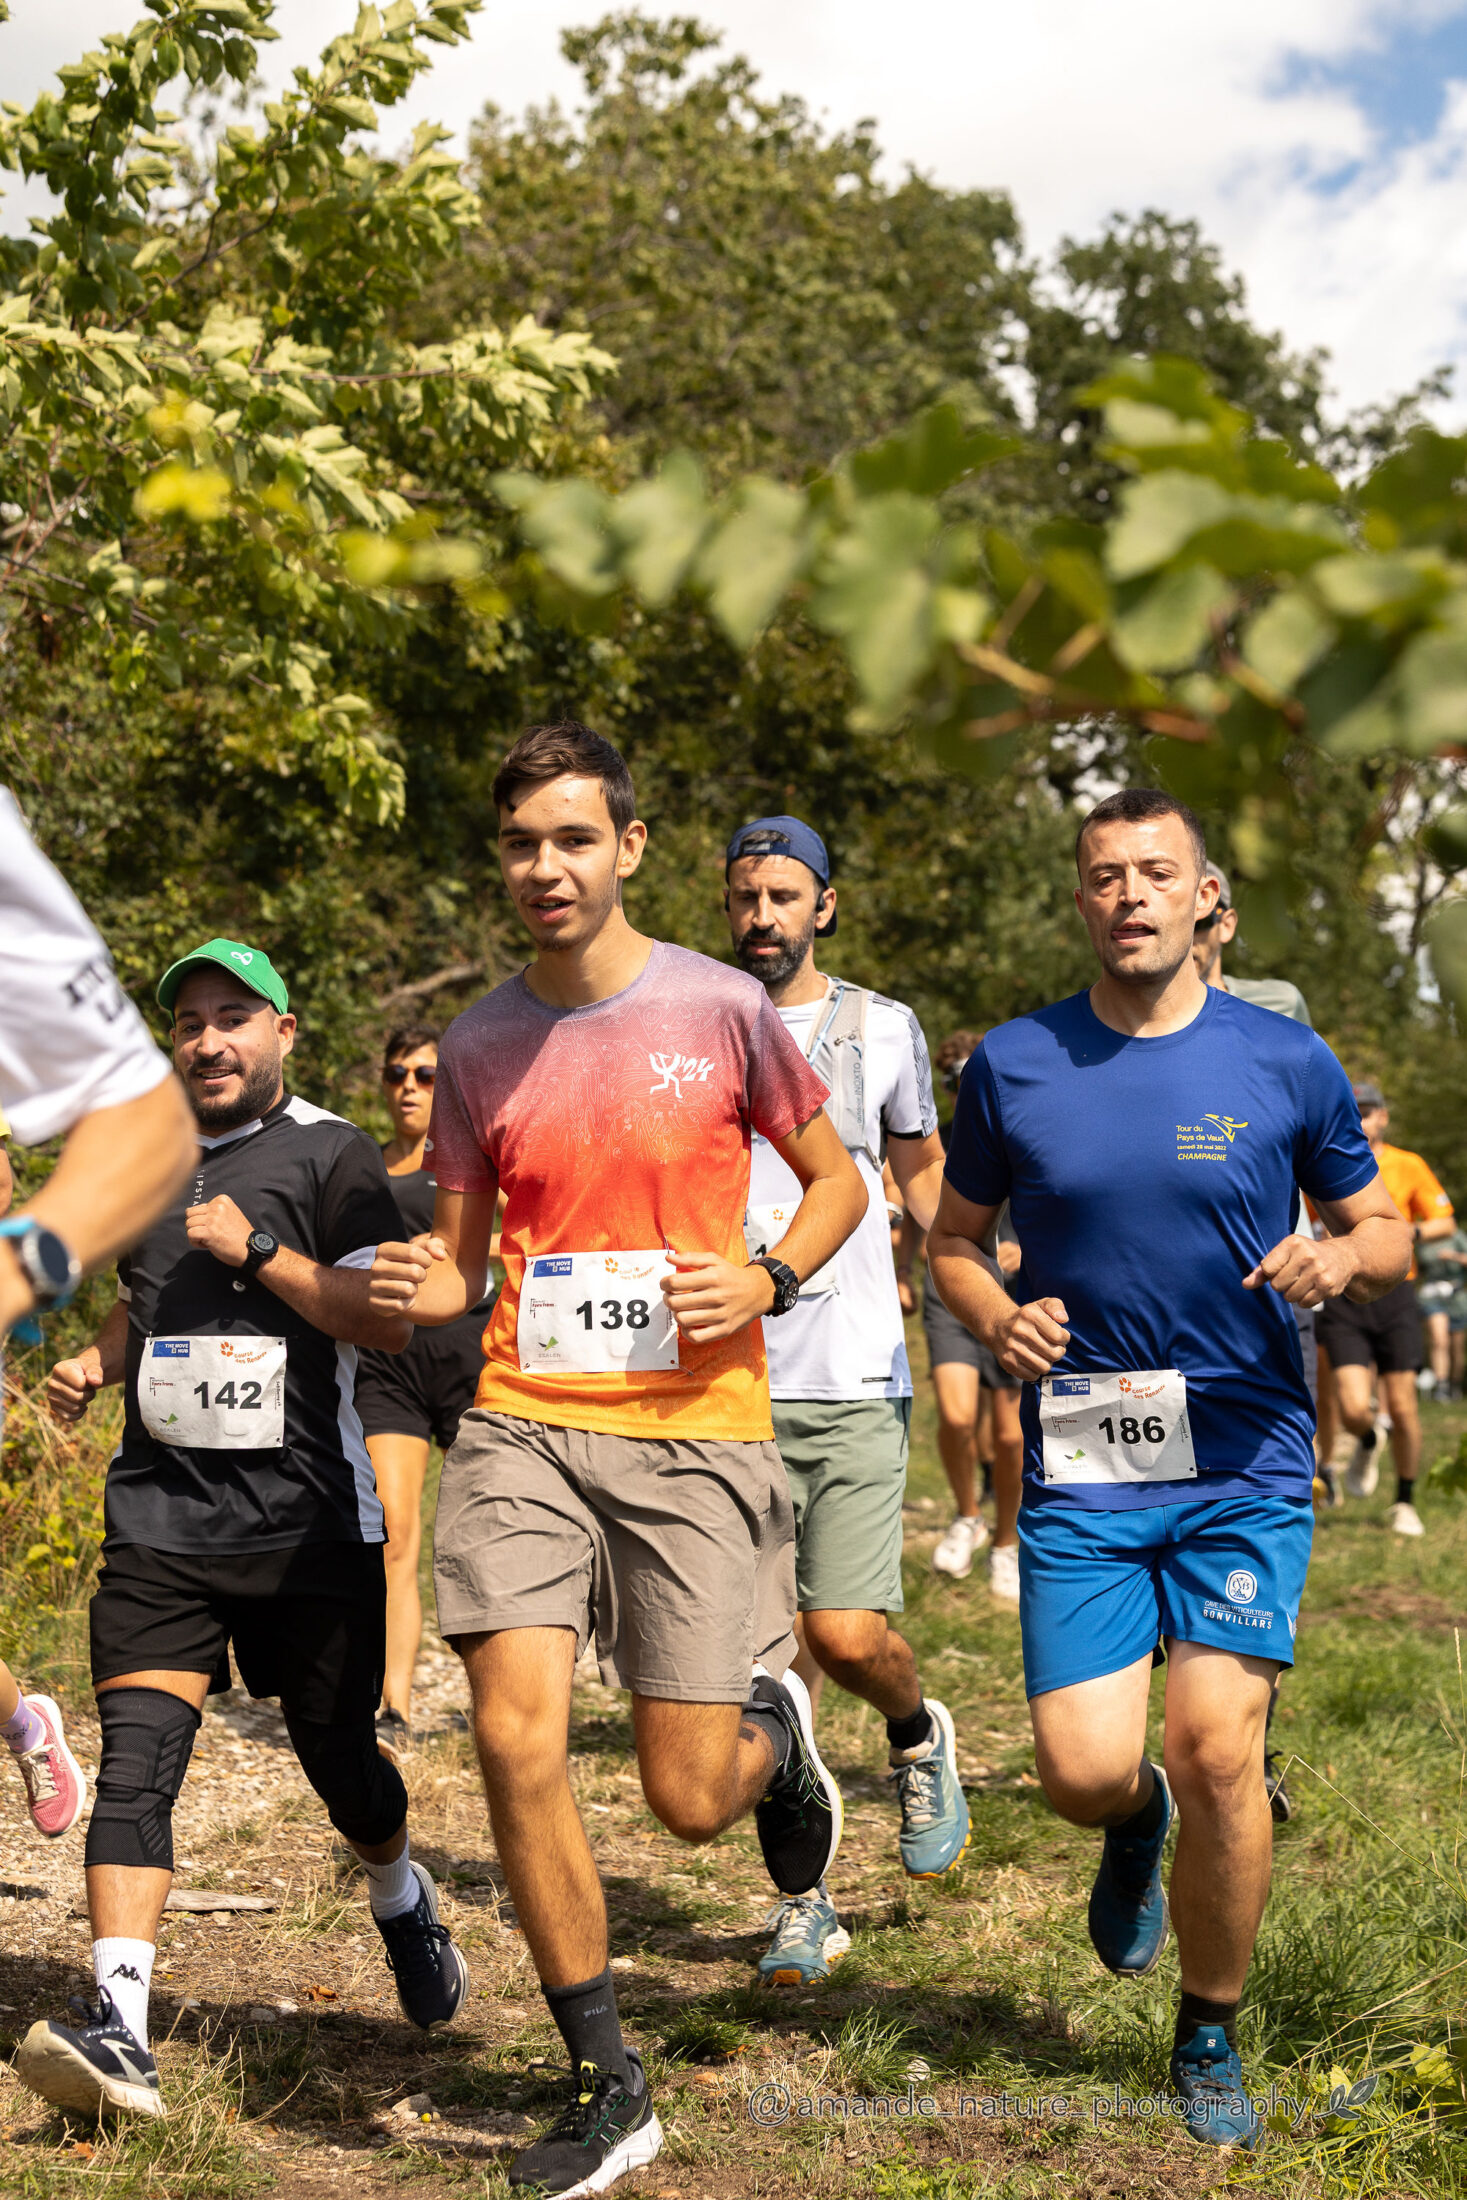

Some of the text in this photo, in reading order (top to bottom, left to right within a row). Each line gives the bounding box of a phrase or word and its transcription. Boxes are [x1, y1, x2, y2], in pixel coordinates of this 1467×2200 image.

[1176, 1134, 1195, 1142] Pays
[1207, 1134, 1225, 1142] Vaud
[1177, 1153, 1227, 1161] CHAMPAGNE
[576, 1299, 650, 1331] 138
[194, 1381, 262, 1409] 142
[1099, 1416, 1165, 1444] 186
[1203, 1609, 1272, 1630] BONVILLARS
[1204, 1600, 1218, 1608] CAVE
[1231, 1605, 1274, 1618] VITICULTEURS
